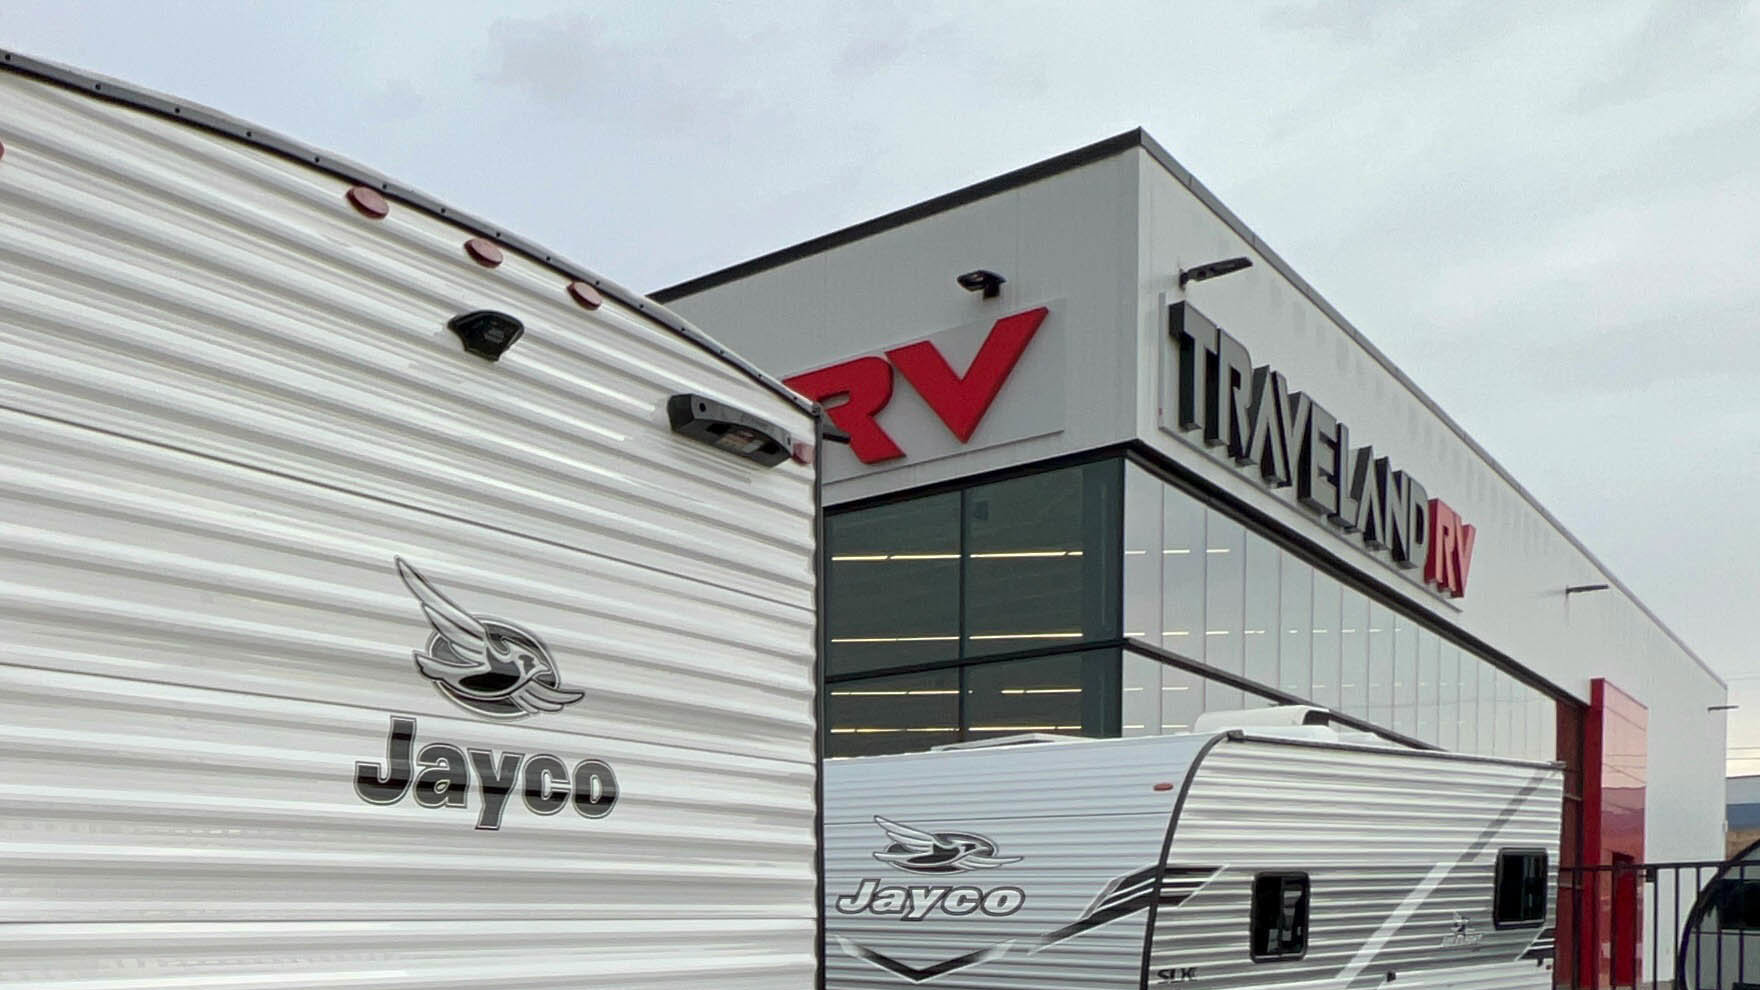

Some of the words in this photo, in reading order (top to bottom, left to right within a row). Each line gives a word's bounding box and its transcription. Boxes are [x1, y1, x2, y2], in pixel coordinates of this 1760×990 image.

[782, 306, 1049, 464] RV
[1169, 300, 1429, 570] TRAVELAND
[1423, 498, 1476, 598] RV
[353, 715, 619, 830] Jayco
[836, 878, 1026, 921] Jayco
